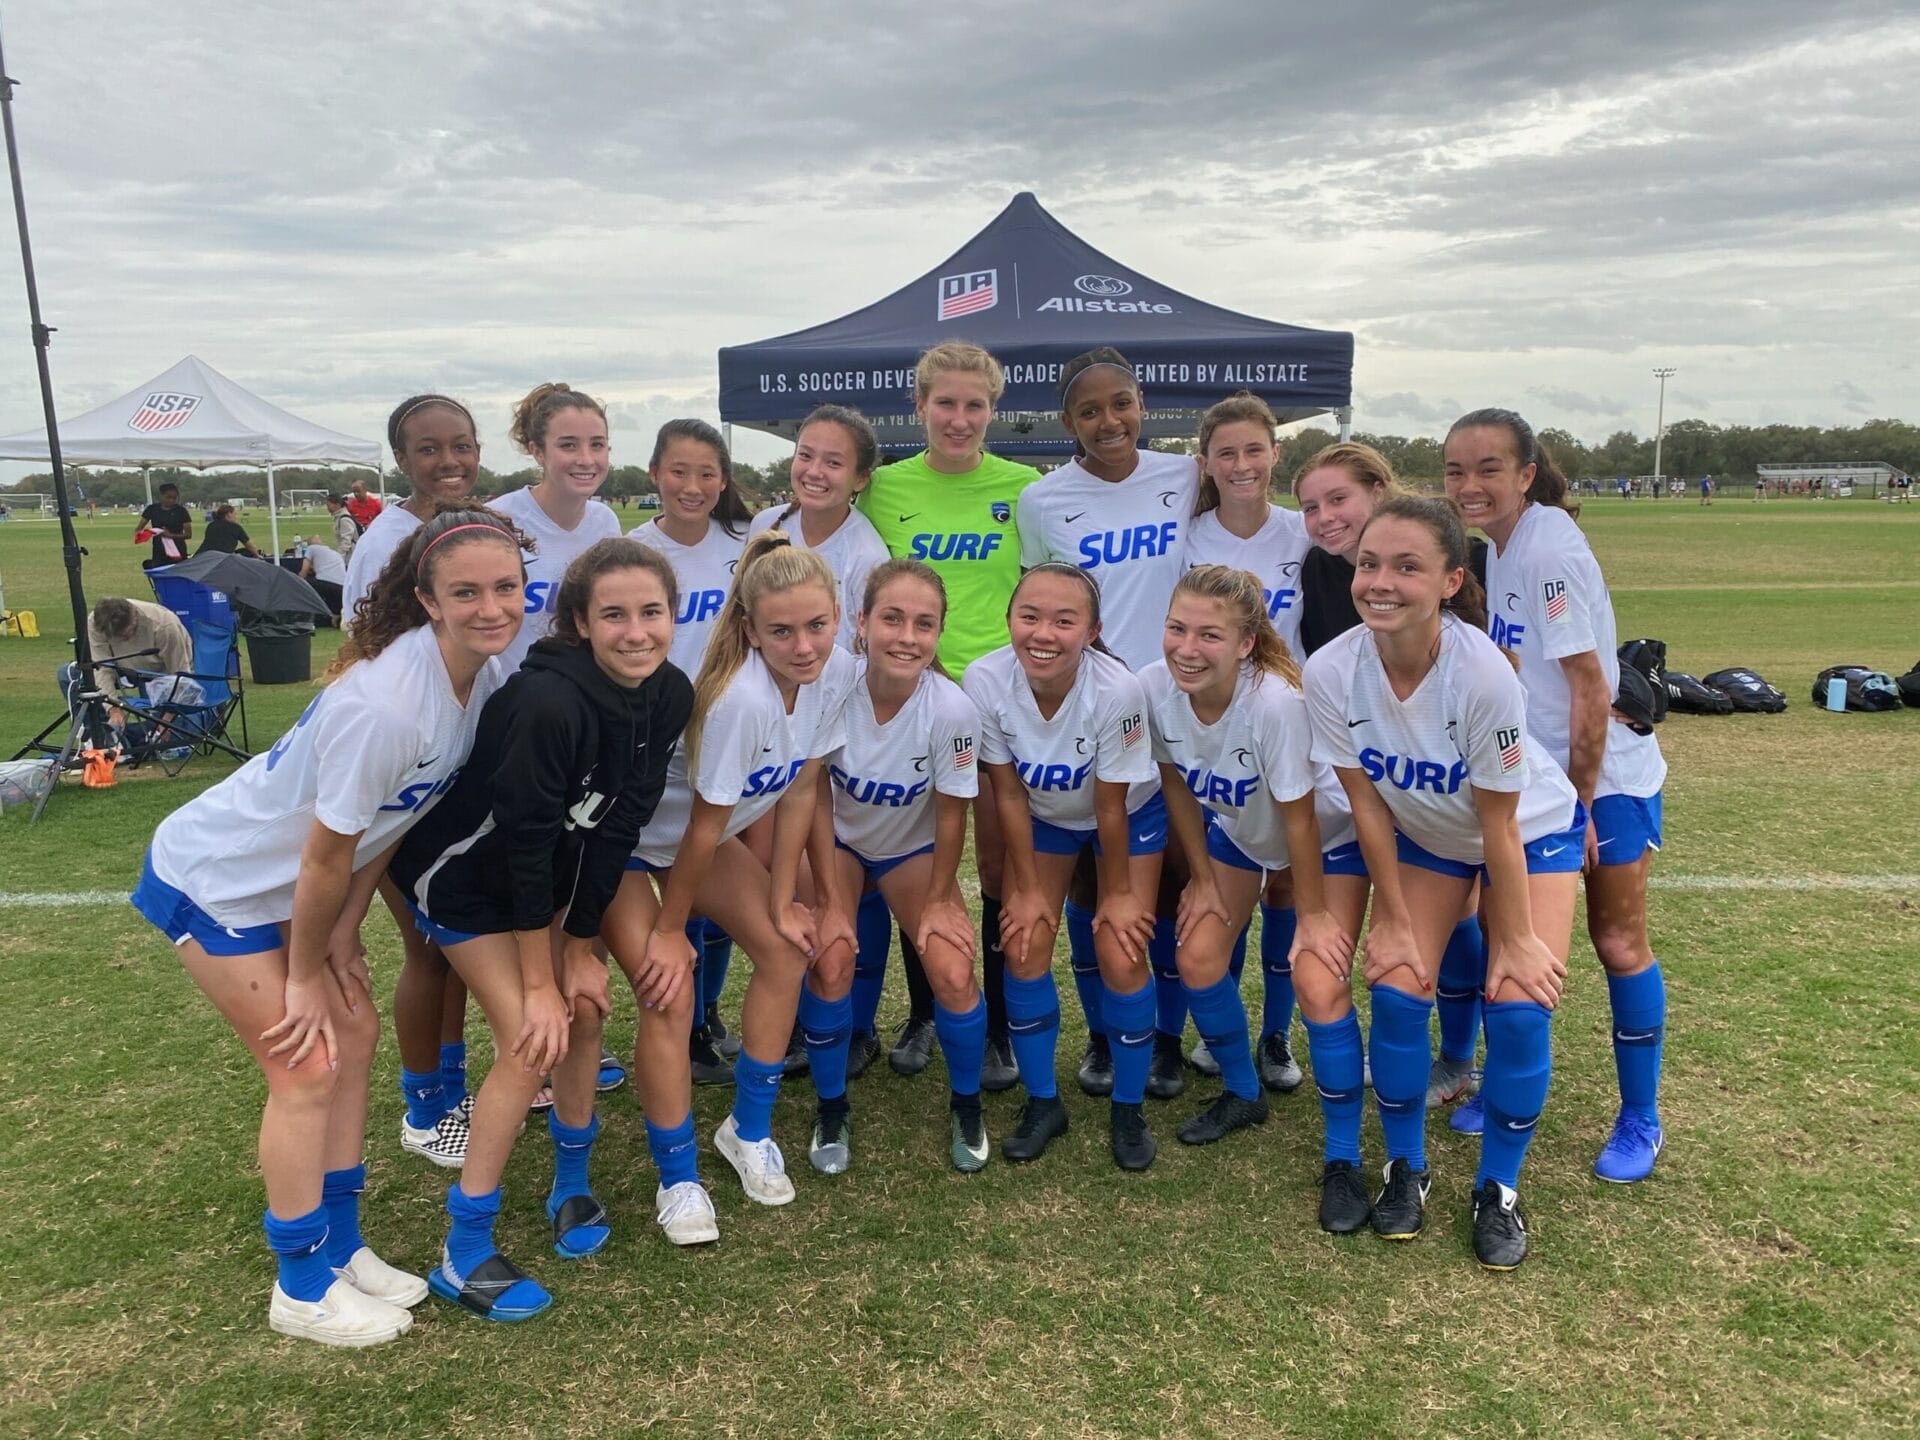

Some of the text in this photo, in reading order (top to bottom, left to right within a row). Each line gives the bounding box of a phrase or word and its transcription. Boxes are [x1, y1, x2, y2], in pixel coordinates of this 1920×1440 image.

[943, 272, 993, 298] DA
[1036, 297, 1173, 314] Allstate
[760, 363, 1308, 393] U.S. SOCCER DEVE ACADE ENTED BY ALLSTATE
[146, 394, 196, 413] USA
[908, 533, 1003, 561] SURF
[1079, 522, 1177, 570] SURF
[1544, 580, 1565, 602] DA
[673, 589, 725, 625] UR
[1497, 727, 1520, 751] DA
[829, 763, 929, 807] SURF
[1012, 753, 1094, 792] URF
